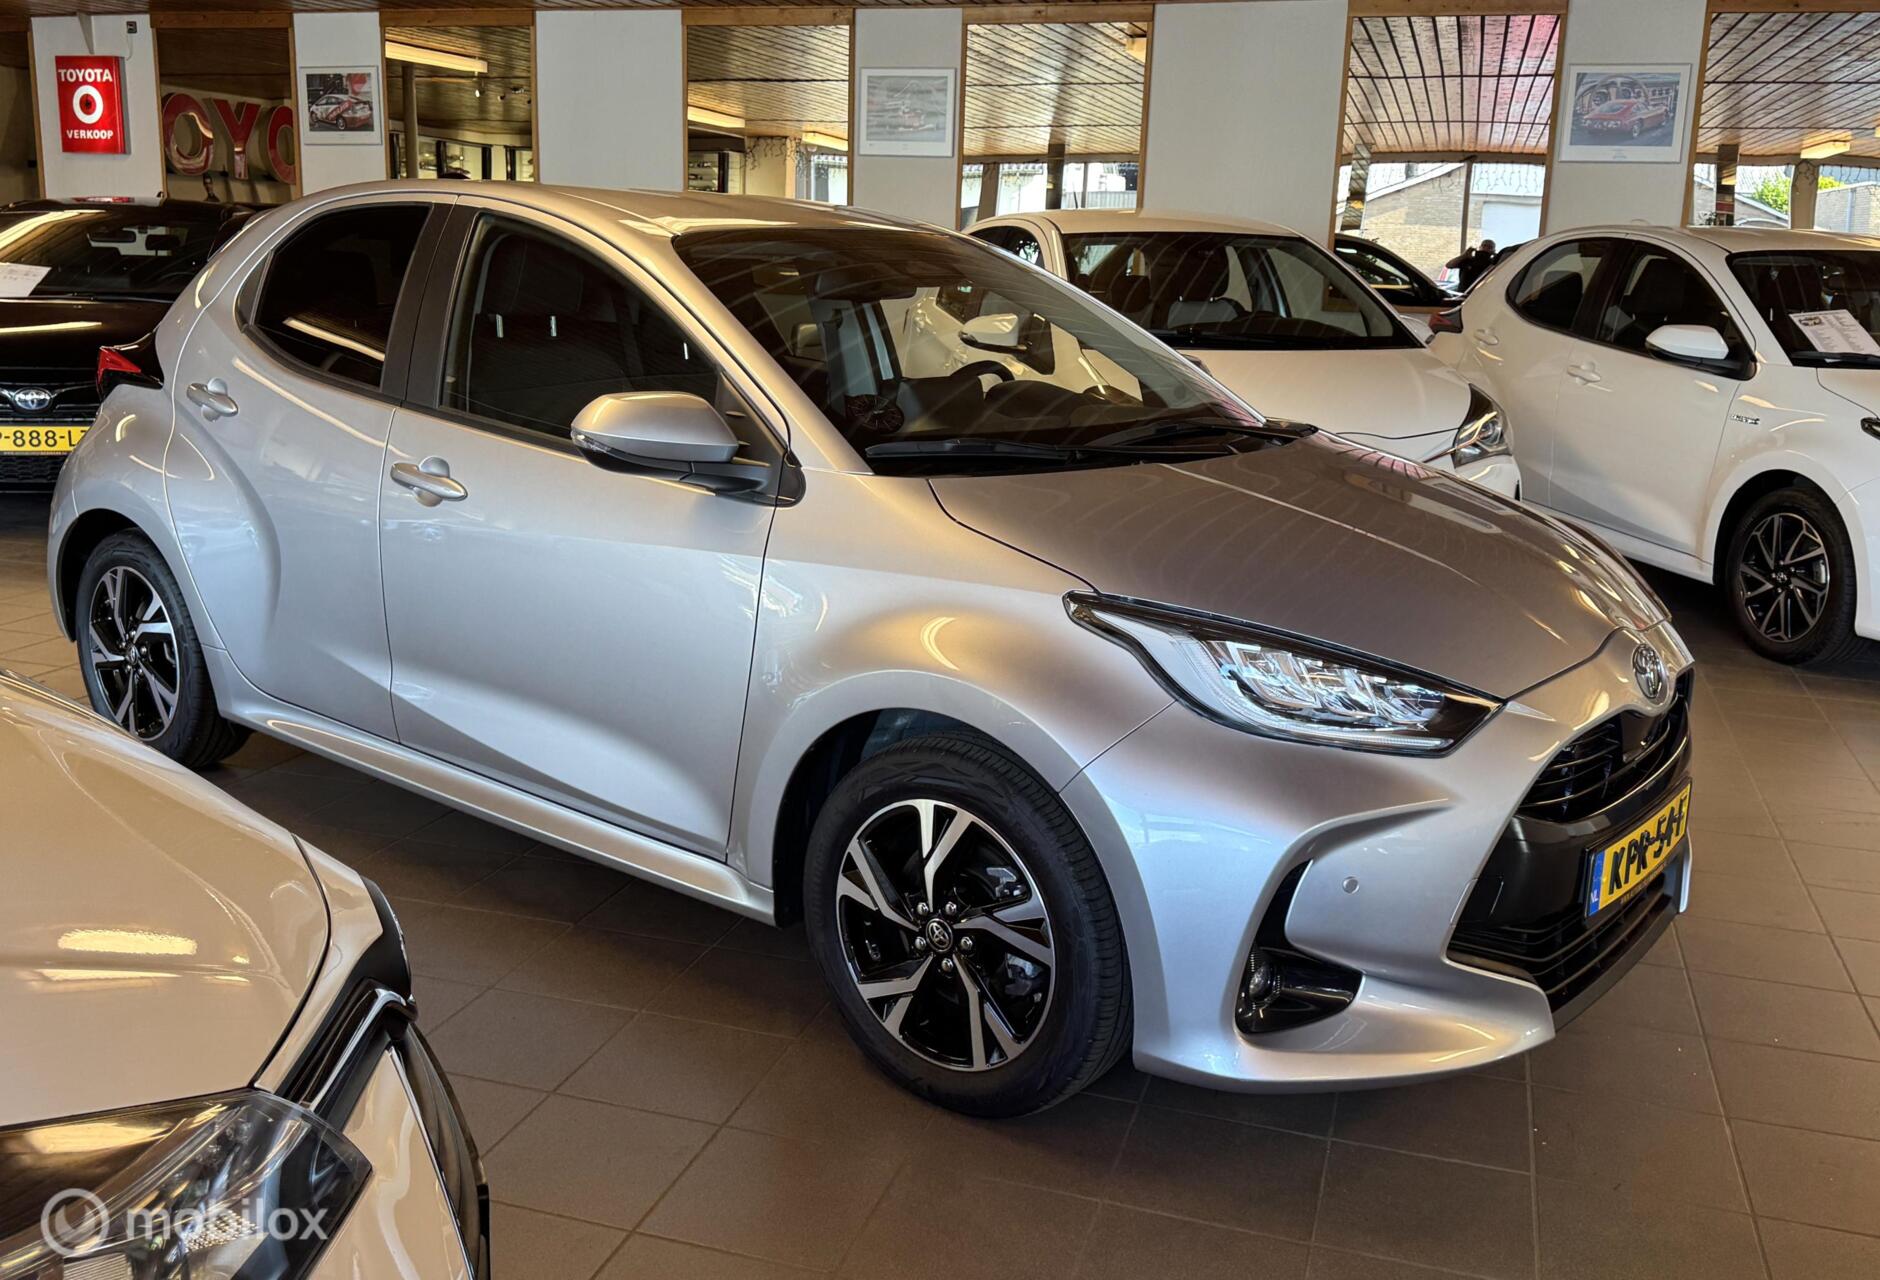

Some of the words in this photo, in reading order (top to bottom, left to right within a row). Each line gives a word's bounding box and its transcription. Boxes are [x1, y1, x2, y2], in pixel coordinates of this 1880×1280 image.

[58, 68, 113, 82] TOYOTA
[66, 129, 114, 139] VERKOOP
[0, 429, 87, 448] -888-L
